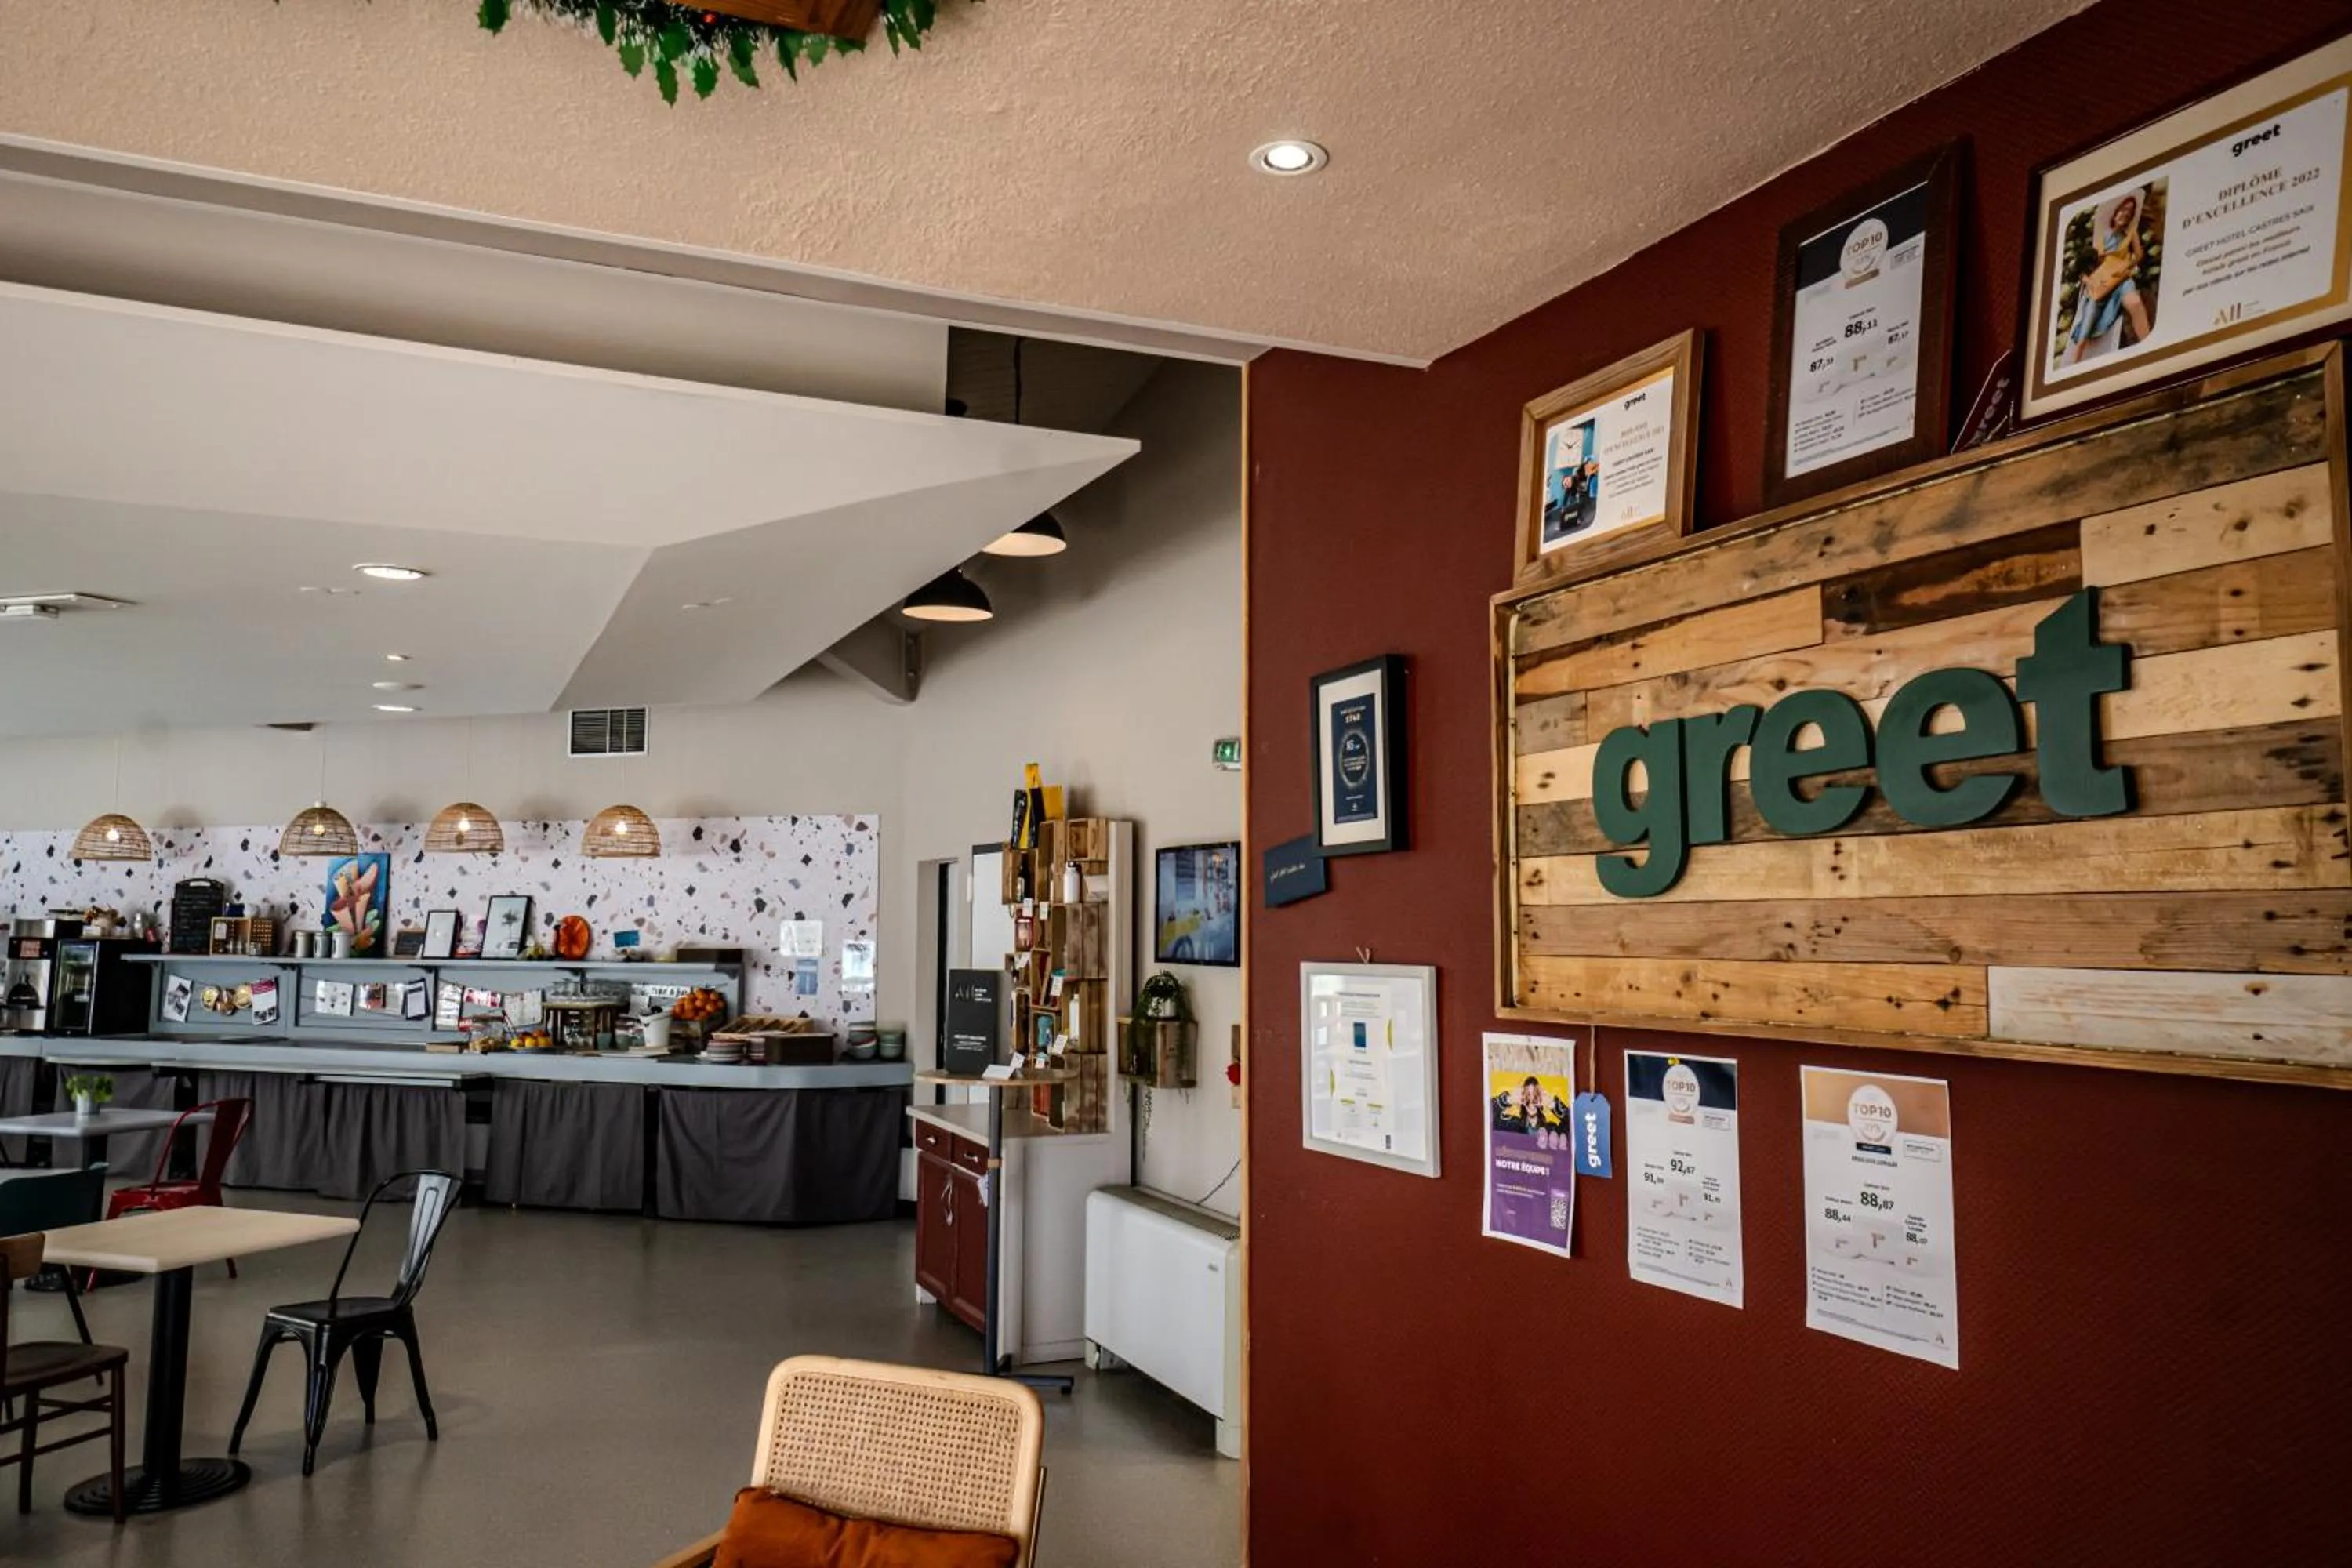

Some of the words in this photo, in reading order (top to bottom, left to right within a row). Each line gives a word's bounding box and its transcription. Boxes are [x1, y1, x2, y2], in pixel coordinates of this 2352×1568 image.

[2232, 123, 2281, 157] greet
[2218, 166, 2282, 201] DIPLÔME
[2292, 167, 2321, 187] 2022
[1592, 586, 2134, 898] greet
[1585, 1112, 1602, 1167] greet
